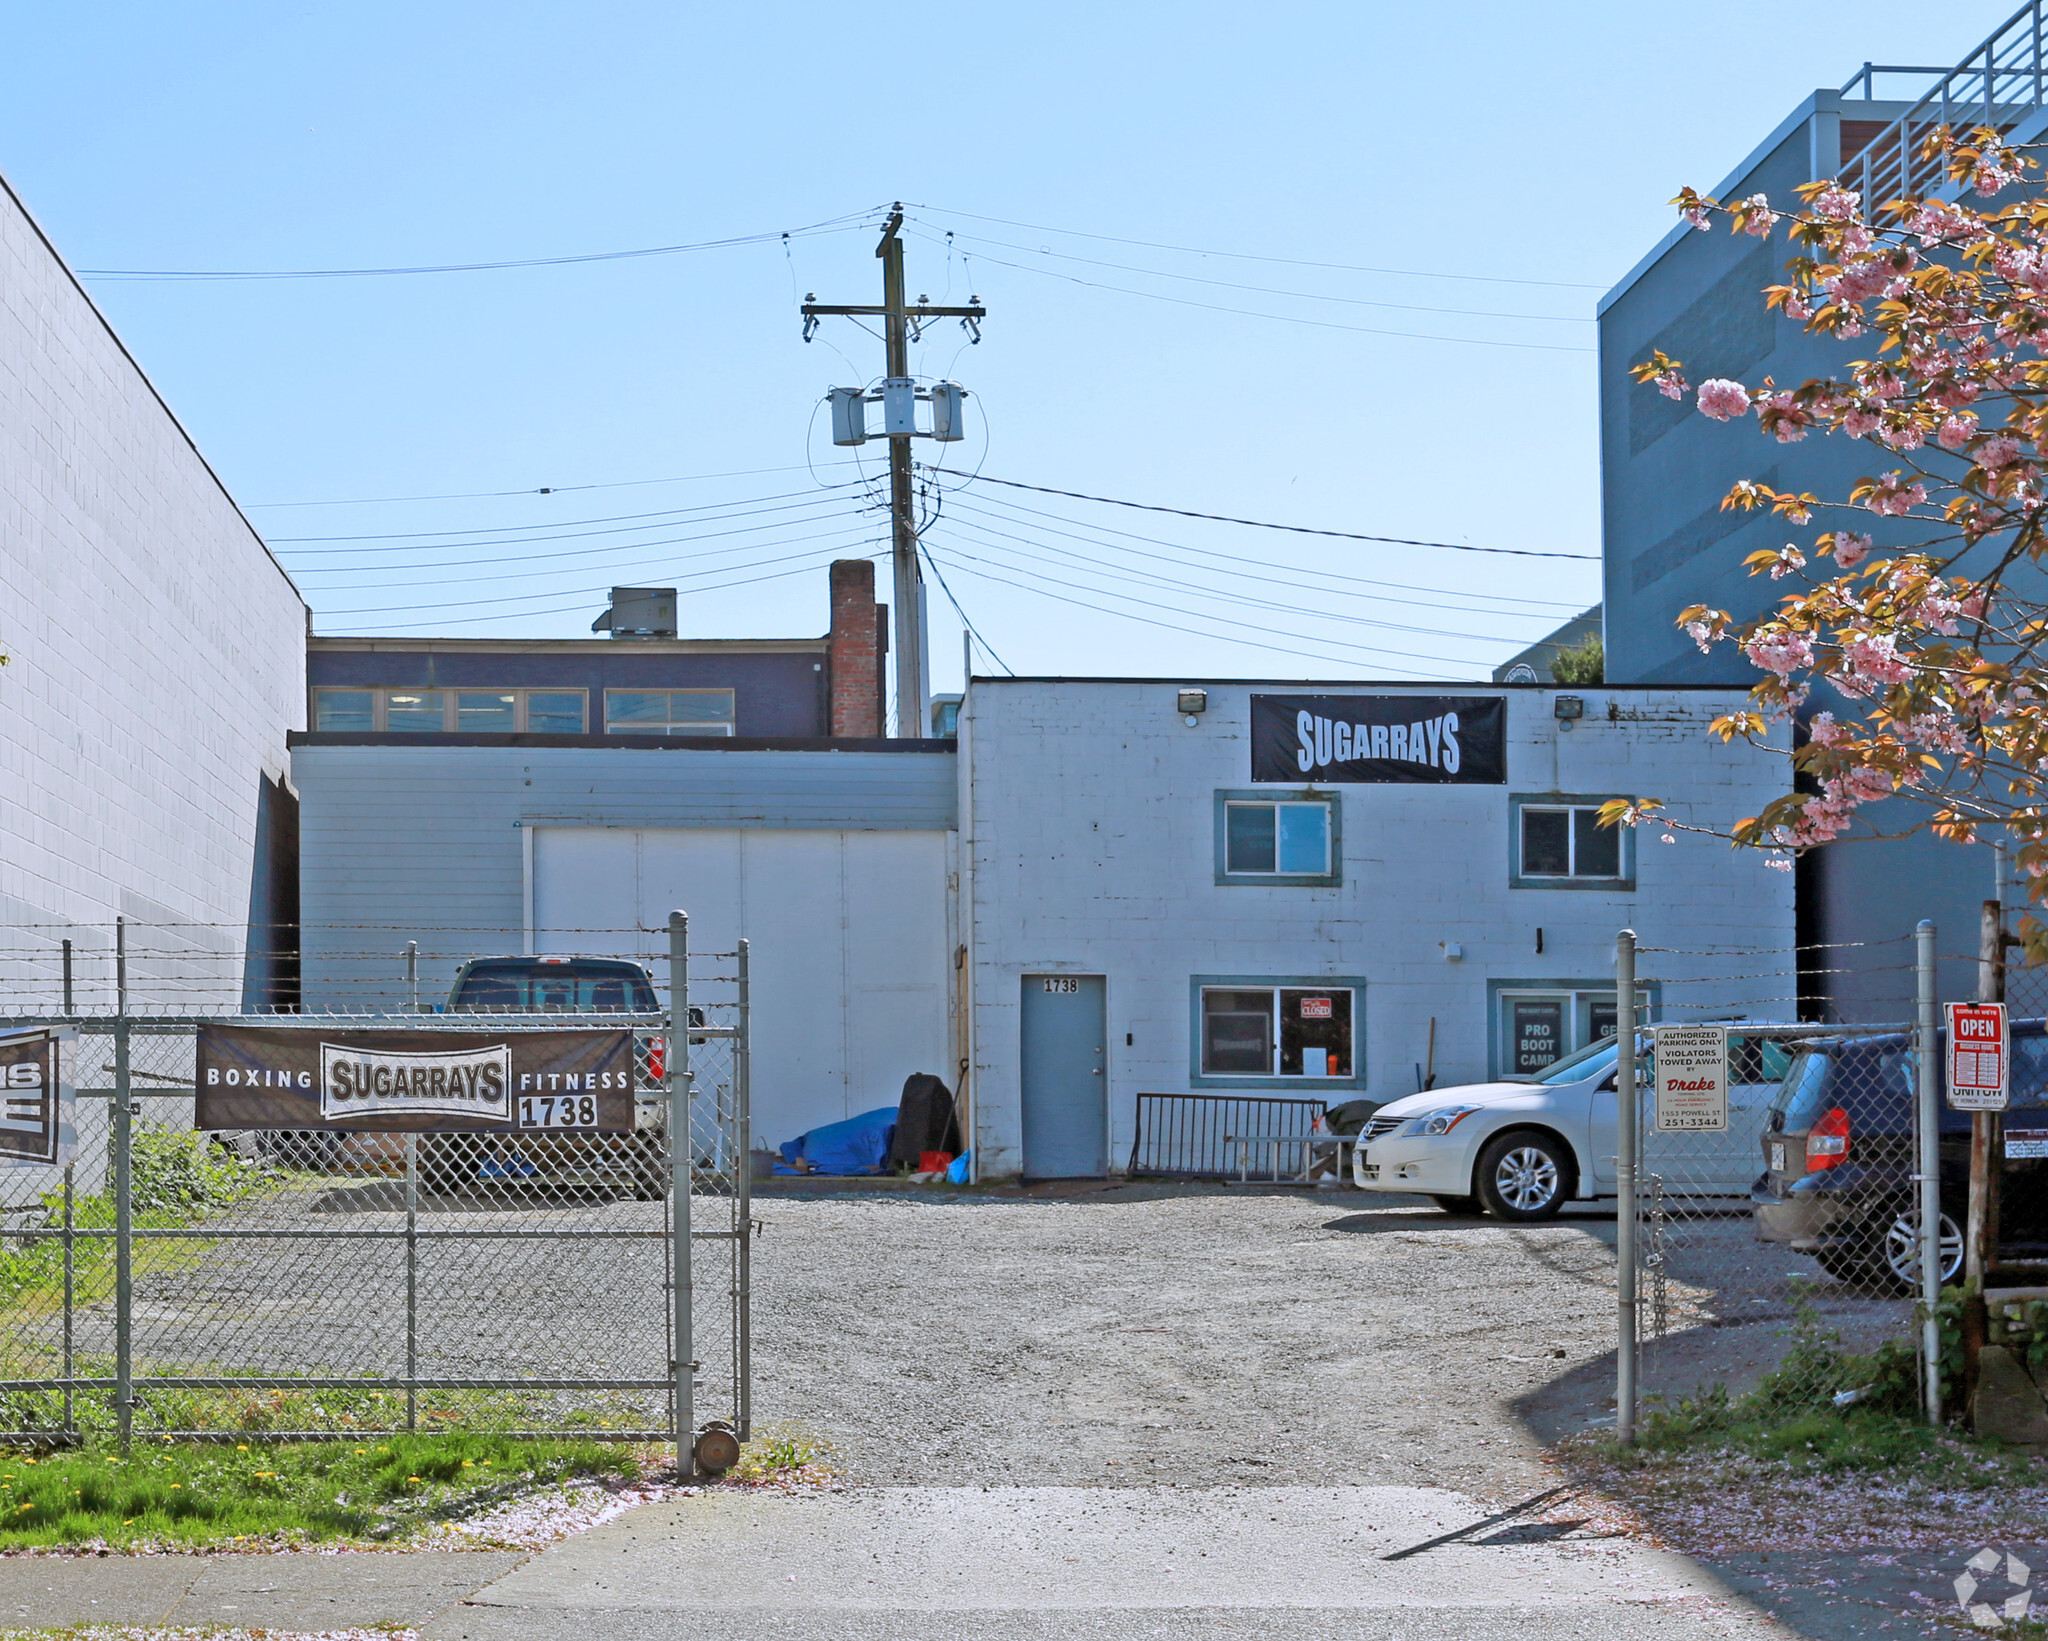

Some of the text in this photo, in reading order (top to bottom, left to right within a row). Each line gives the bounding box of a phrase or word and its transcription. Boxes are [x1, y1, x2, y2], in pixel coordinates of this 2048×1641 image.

[1297, 709, 1460, 774] SUGARRAYS
[1045, 979, 1078, 992] 1738
[1302, 1006, 1330, 1015] CLOSED
[1525, 1024, 1550, 1036] PRO
[1960, 1018, 1994, 1037] OPEN
[1521, 1039, 1555, 1051] BOOT
[1520, 1054, 1556, 1066] CAMP
[207, 1068, 312, 1089] BOXING
[330, 1059, 504, 1104] SUGARRAYS
[520, 1071, 628, 1091] FITNESS
[1667, 1076, 1716, 1091] Drake
[521, 1096, 595, 1127] 1738
[1665, 1118, 1718, 1126] 251-3344
